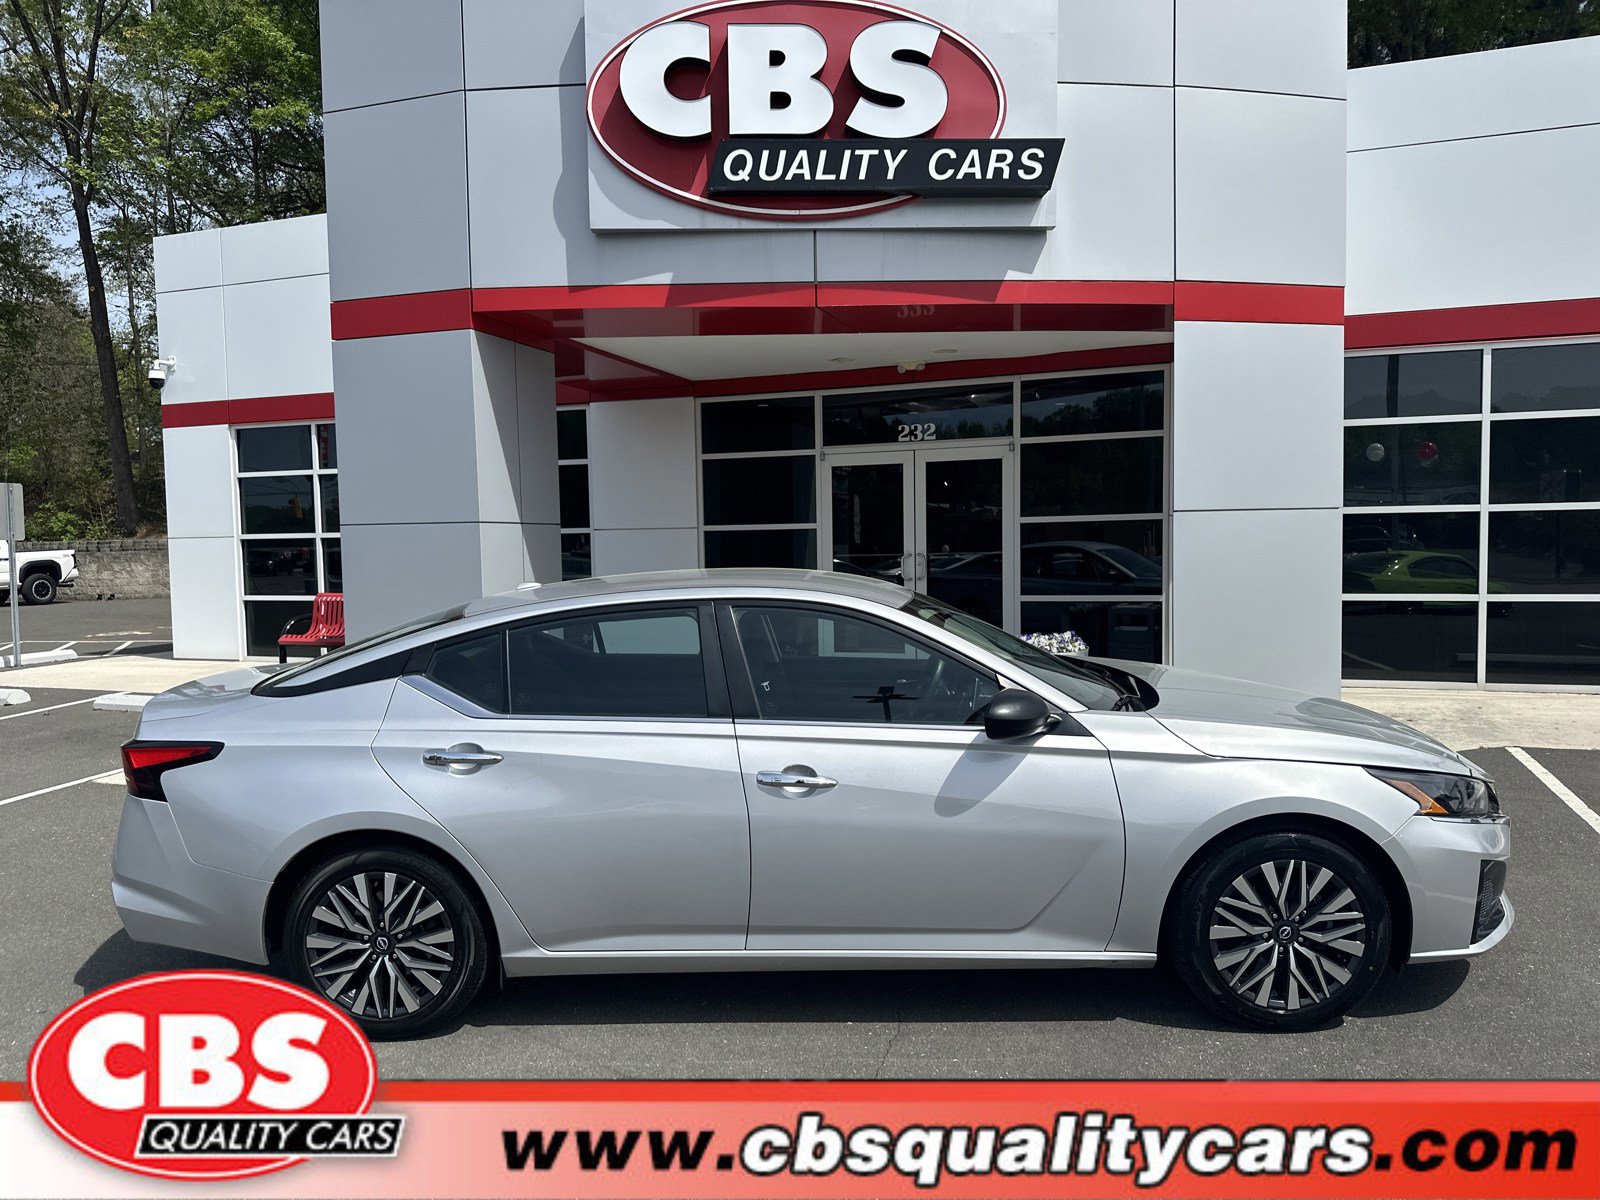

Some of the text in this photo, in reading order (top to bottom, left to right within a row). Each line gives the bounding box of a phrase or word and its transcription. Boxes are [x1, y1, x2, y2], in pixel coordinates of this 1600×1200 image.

[619, 20, 948, 139] CBS
[722, 147, 1046, 183] QUALITY CARS
[897, 423, 937, 442] 232
